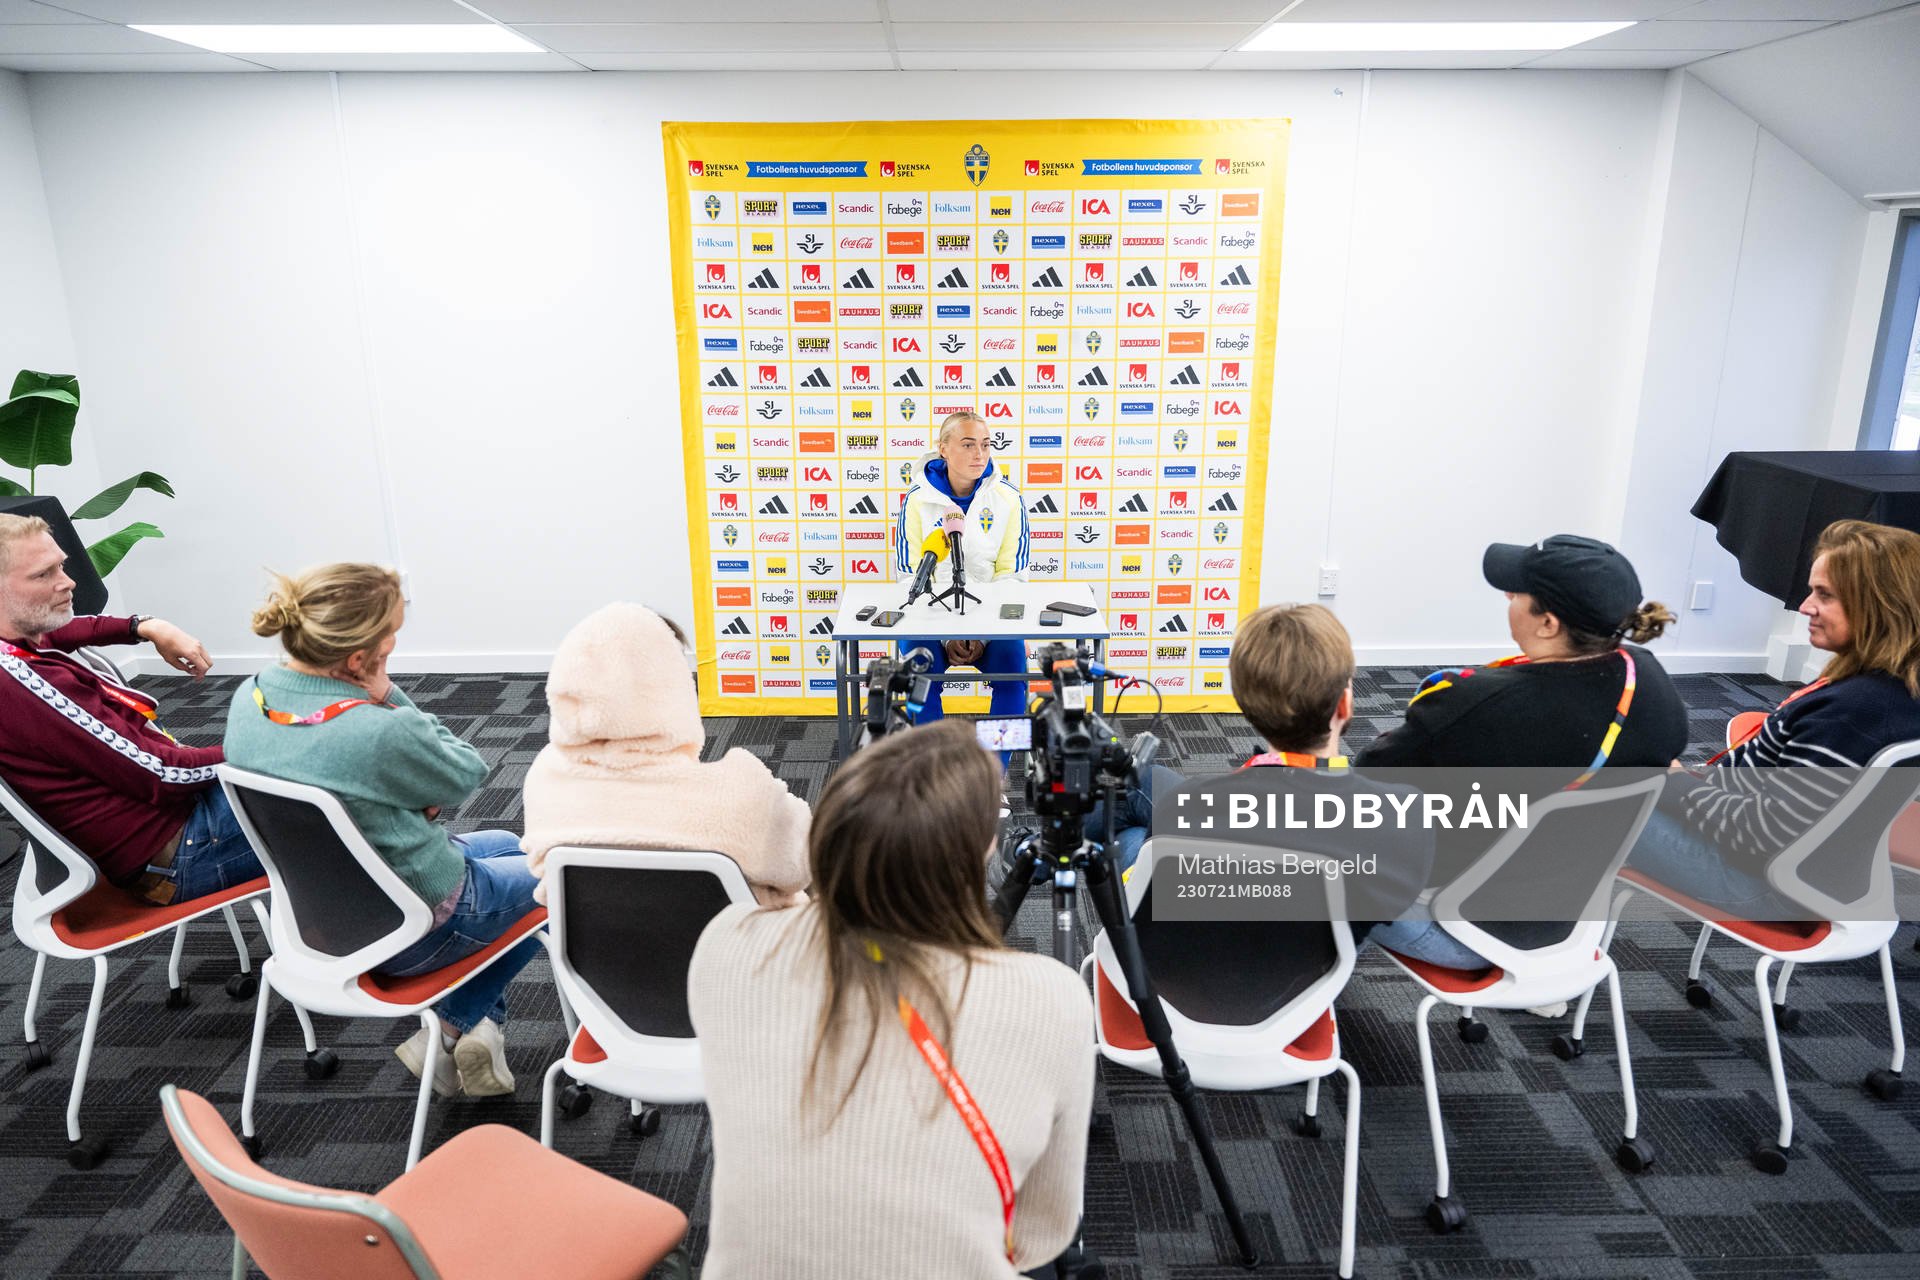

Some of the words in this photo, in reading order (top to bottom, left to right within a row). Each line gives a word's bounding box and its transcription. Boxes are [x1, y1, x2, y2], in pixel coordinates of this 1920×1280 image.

[756, 165, 798, 173] Fotbollens
[800, 165, 857, 175] huvudsponsor
[1092, 163, 1133, 171] Fotbollens
[1135, 163, 1192, 172] huvudsponsor
[1188, 194, 1198, 204] SJ
[744, 201, 778, 213] SPORT
[838, 204, 874, 213] Scandic
[887, 203, 922, 218] Fabege
[935, 203, 971, 212] Folksam
[1082, 198, 1111, 215] ICA
[697, 238, 734, 247] Folksam
[805, 234, 815, 243] SJ
[937, 235, 970, 247] SPORT
[1080, 234, 1112, 246] SPORT
[1173, 237, 1208, 245] Scandic
[1220, 236, 1255, 249] Fabege
[1183, 299, 1193, 308] SJ
[703, 303, 733, 319] ICA
[748, 307, 782, 316] Scandic
[890, 304, 923, 316] SPORT
[983, 306, 1017, 315] Scandic
[1030, 306, 1064, 320] Fabege
[1077, 306, 1112, 314] Folksam
[1127, 302, 1156, 318] ICA
[798, 338, 830, 349] SPORT
[947, 334, 957, 343] SJ
[750, 340, 784, 354] Fabege
[843, 341, 878, 350] Scandic
[892, 337, 922, 353] ICA
[1215, 338, 1249, 351] Fabege
[764, 400, 774, 409] SJ
[1214, 400, 1242, 416] ICA
[799, 406, 834, 415] Folksam
[985, 403, 1012, 417] ICA
[1029, 406, 1063, 414] Folksam
[1166, 404, 1200, 417] Fabege
[995, 432, 1004, 440] SJ
[1119, 437, 1153, 445] Folksam
[753, 438, 789, 447] Scandic
[847, 436, 879, 447] SPORT
[891, 438, 924, 447] Scandic
[722, 464, 732, 473] SJ
[757, 468, 789, 478] SPORT
[1075, 466, 1103, 480] ICA
[1116, 468, 1152, 477] Scandic
[804, 467, 833, 482] ICA
[846, 470, 880, 483] Fabege
[1208, 468, 1241, 481] Fabege
[1083, 525, 1092, 534] SJ
[1160, 530, 1193, 538] Scandic
[804, 532, 837, 540] Folksam
[816, 557, 826, 566] SJ
[851, 559, 879, 574] ICA
[1071, 561, 1104, 569] Folksam
[1030, 562, 1058, 574] abege
[762, 592, 794, 605] Fabege
[807, 590, 838, 600] SPORT
[1204, 587, 1231, 601] ICA
[1157, 647, 1187, 657] SPORT
[942, 681, 970, 690] abege
[1115, 676, 1140, 688] ICA
